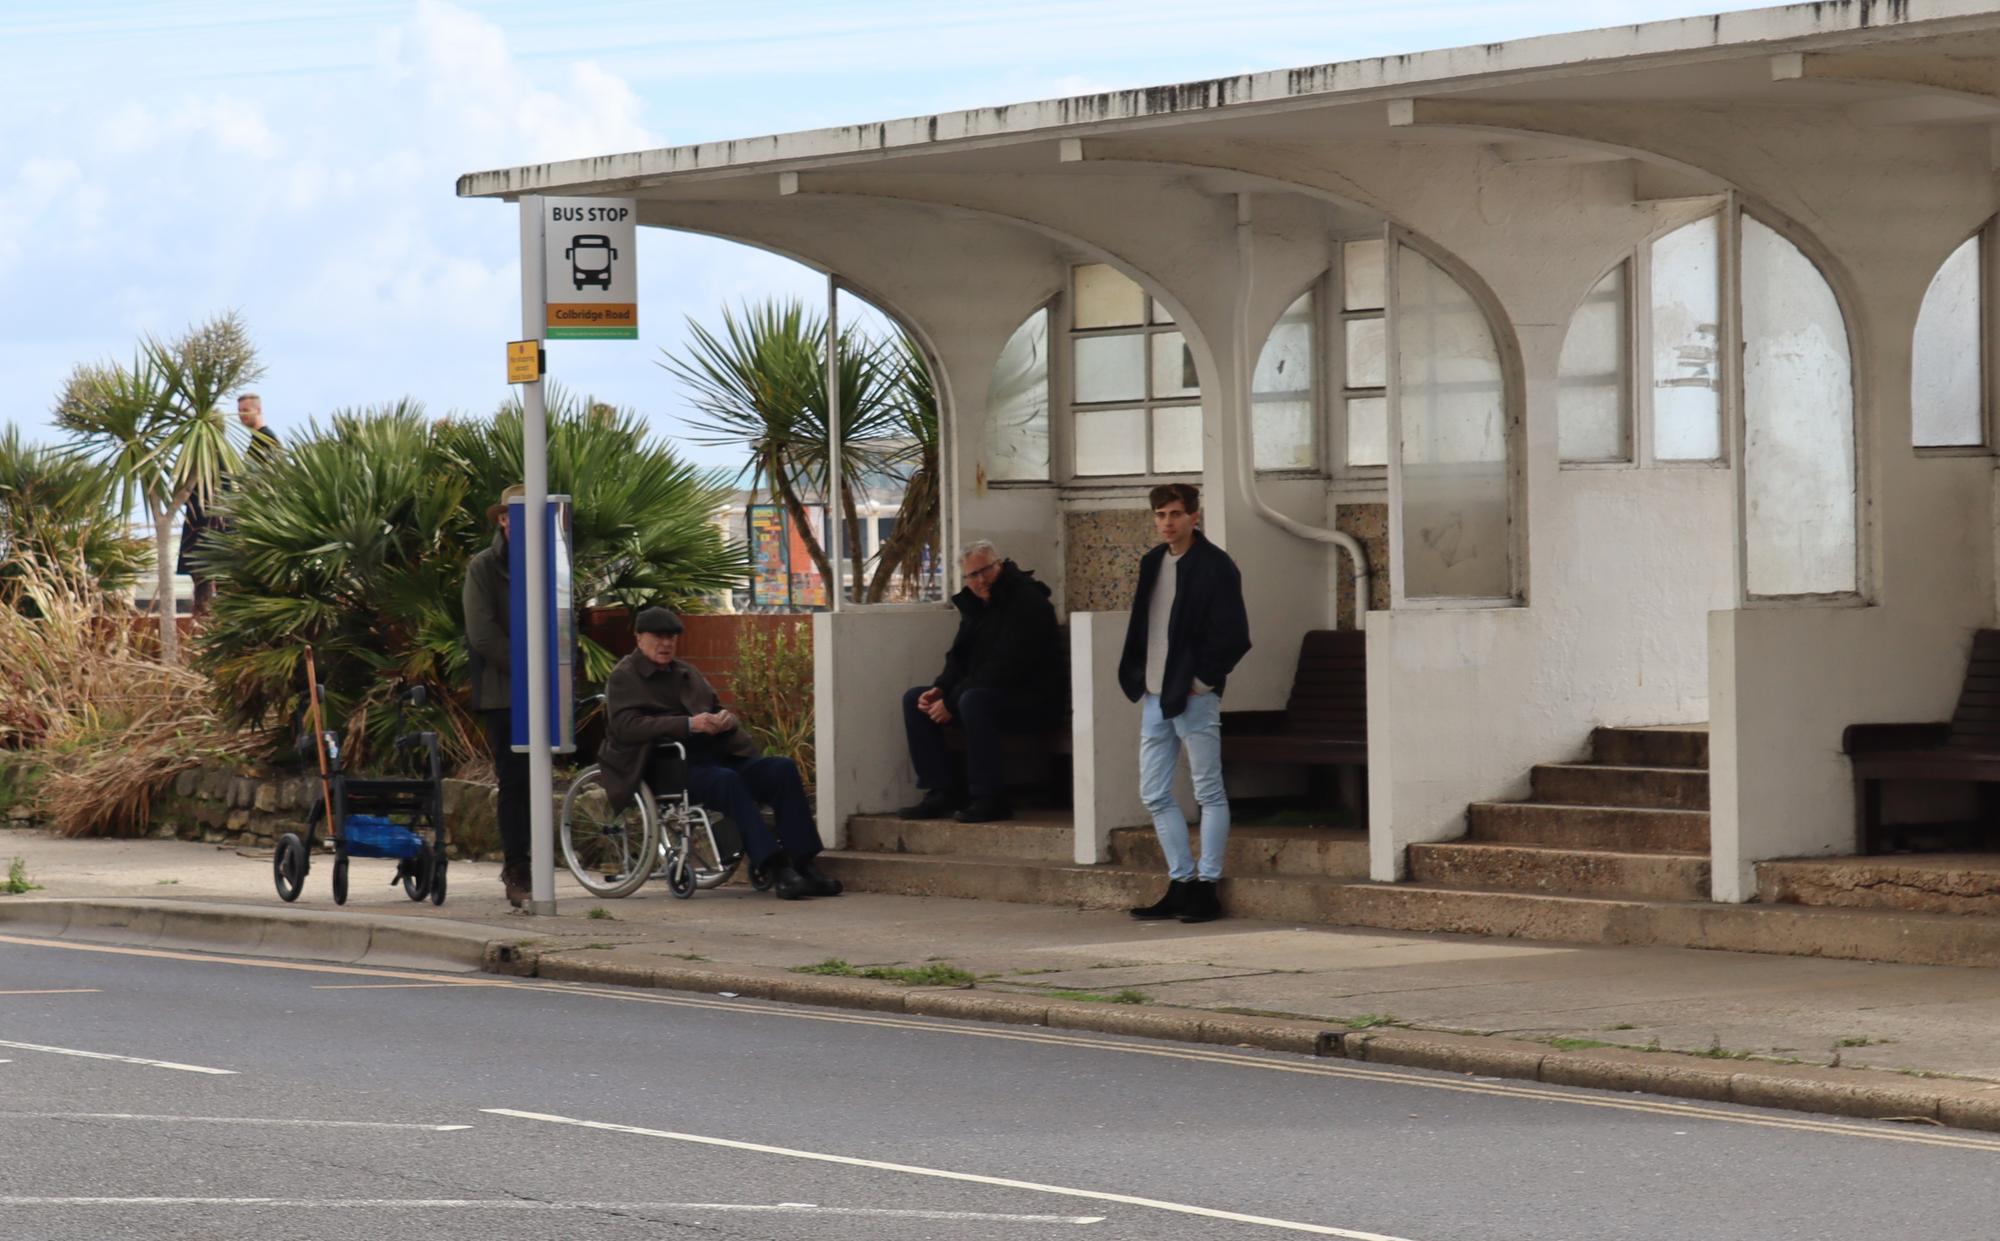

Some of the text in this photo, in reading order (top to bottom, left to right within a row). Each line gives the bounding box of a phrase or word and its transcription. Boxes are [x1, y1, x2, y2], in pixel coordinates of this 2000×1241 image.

[553, 207, 628, 221] BUS STOP
[555, 310, 630, 321] Colbridge Road
